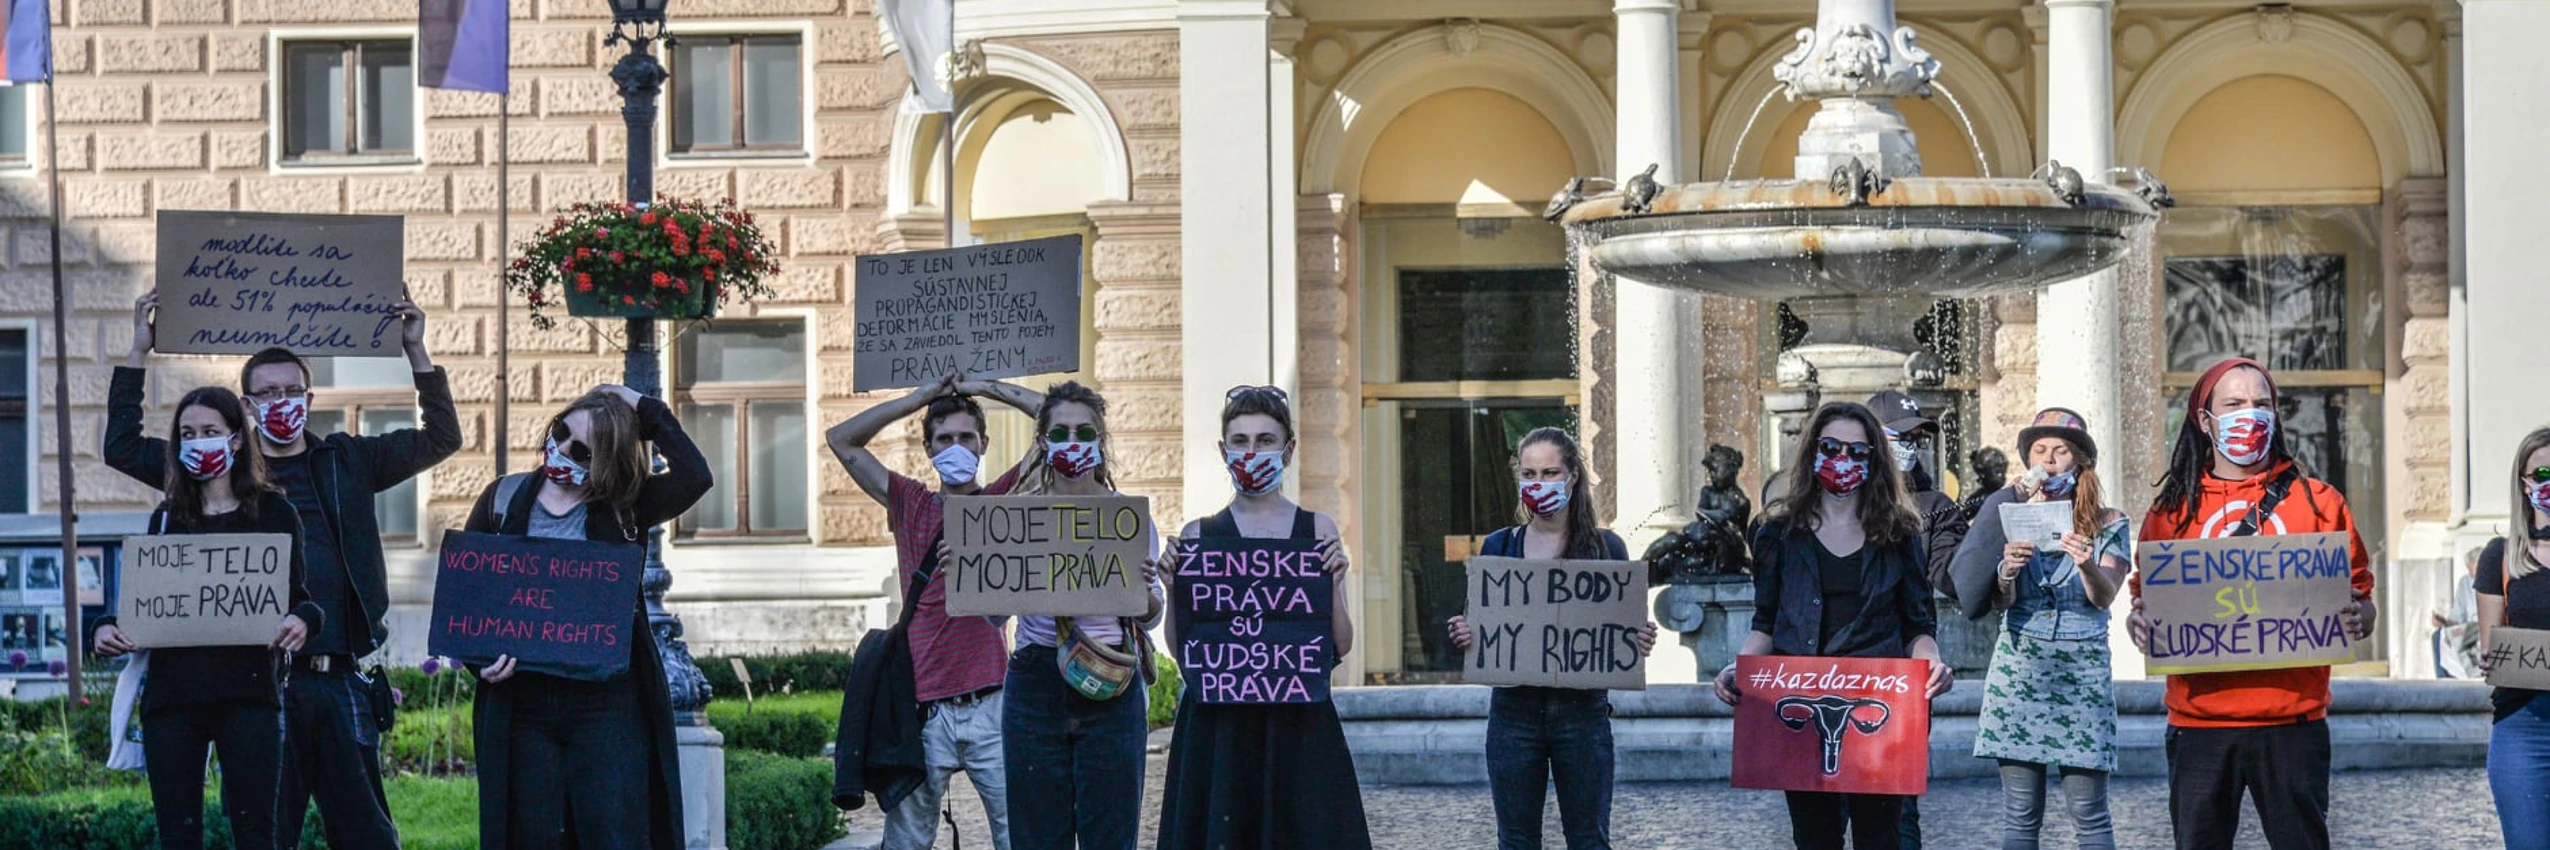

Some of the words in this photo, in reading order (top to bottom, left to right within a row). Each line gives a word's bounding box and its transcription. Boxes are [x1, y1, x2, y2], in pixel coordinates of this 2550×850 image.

[202, 234, 298, 257] modlite
[309, 244, 352, 260] sa
[184, 255, 258, 281] koľko
[269, 266, 353, 288] chcete
[867, 259, 889, 276] TO
[897, 258, 916, 275] JE
[924, 256, 954, 273] LEN
[189, 288, 221, 307] ale
[231, 289, 277, 312] 51%
[911, 273, 1008, 298] SÚSTAVNEJ
[875, 291, 1037, 318] PROPAGANDISTICKEJ
[879, 338, 898, 353] SA
[903, 333, 965, 351] ZAVIEDOL
[971, 327, 1010, 344] TENTO
[1018, 324, 1056, 340] POJEM
[890, 353, 959, 383] PRÁVA
[966, 345, 1026, 374] ŽENY
[963, 505, 1049, 547] MOJE
[1052, 503, 1140, 542] TELO
[137, 543, 195, 572] MOJE
[199, 546, 278, 574] TELO
[444, 550, 541, 576] WOMEN'S
[549, 556, 620, 582] RIGHTS
[956, 553, 1048, 593] MOJE
[1049, 546, 1130, 593] PRÁVA
[1176, 542, 1325, 578] ŽENSKÉ
[2146, 542, 2281, 586] ŽENSKÉ
[2278, 537, 2350, 580] PRÁVA
[135, 594, 191, 618] MOJE
[199, 577, 281, 617] PRÁVA
[509, 588, 556, 609] ARE
[1191, 580, 1314, 614] PRÁVA
[1481, 569, 1534, 607] MY
[1547, 568, 1632, 604] BODY
[2213, 580, 2261, 619] SÚ
[447, 615, 534, 639] HUMAN
[541, 621, 617, 646] RIGHTS
[1229, 610, 1264, 637] SÚ
[2257, 607, 2348, 654] PRÁVA
[1476, 623, 1524, 672] MY
[1542, 622, 1640, 674] RIGHTS
[2489, 642, 2550, 671] #KA
[1201, 671, 1312, 703] PRÁVA
[1750, 663, 1910, 694] #kazdaznas
